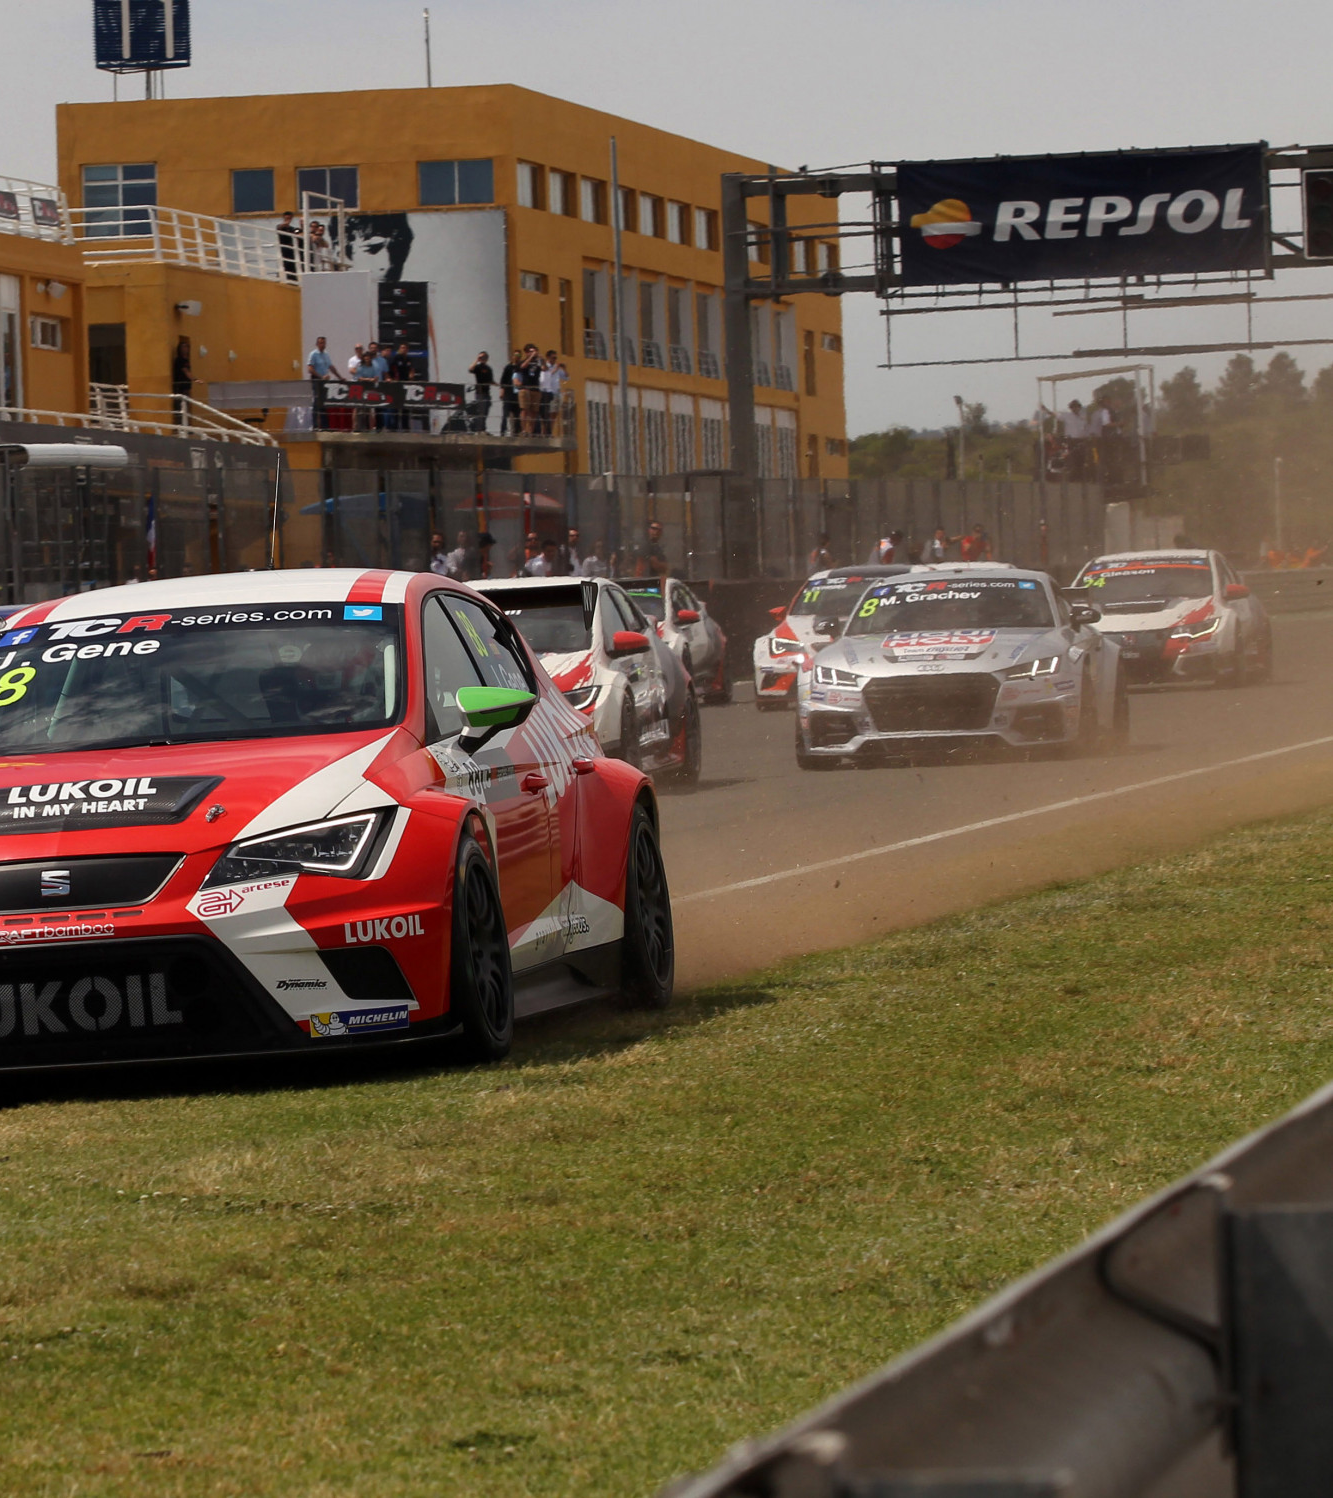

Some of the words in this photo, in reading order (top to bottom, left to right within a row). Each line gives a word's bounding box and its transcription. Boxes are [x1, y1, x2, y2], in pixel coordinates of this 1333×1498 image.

[993, 187, 1252, 242] REPSOL
[323, 382, 364, 401] TCR
[403, 384, 437, 402] TCR
[858, 597, 880, 618] 8
[879, 595, 901, 608] M.
[905, 590, 982, 603] Grachev
[888, 635, 990, 647] MOLY
[42, 638, 162, 664] Gene
[7, 777, 158, 804] LUKOIL
[13, 805, 40, 819] IN
[42, 803, 76, 817] MY
[81, 798, 149, 814] HEART
[241, 879, 291, 894] arcese
[343, 914, 425, 943] LUKOIL
[276, 979, 328, 990] Dynamics
[348, 1010, 408, 1025] MICHELIN
